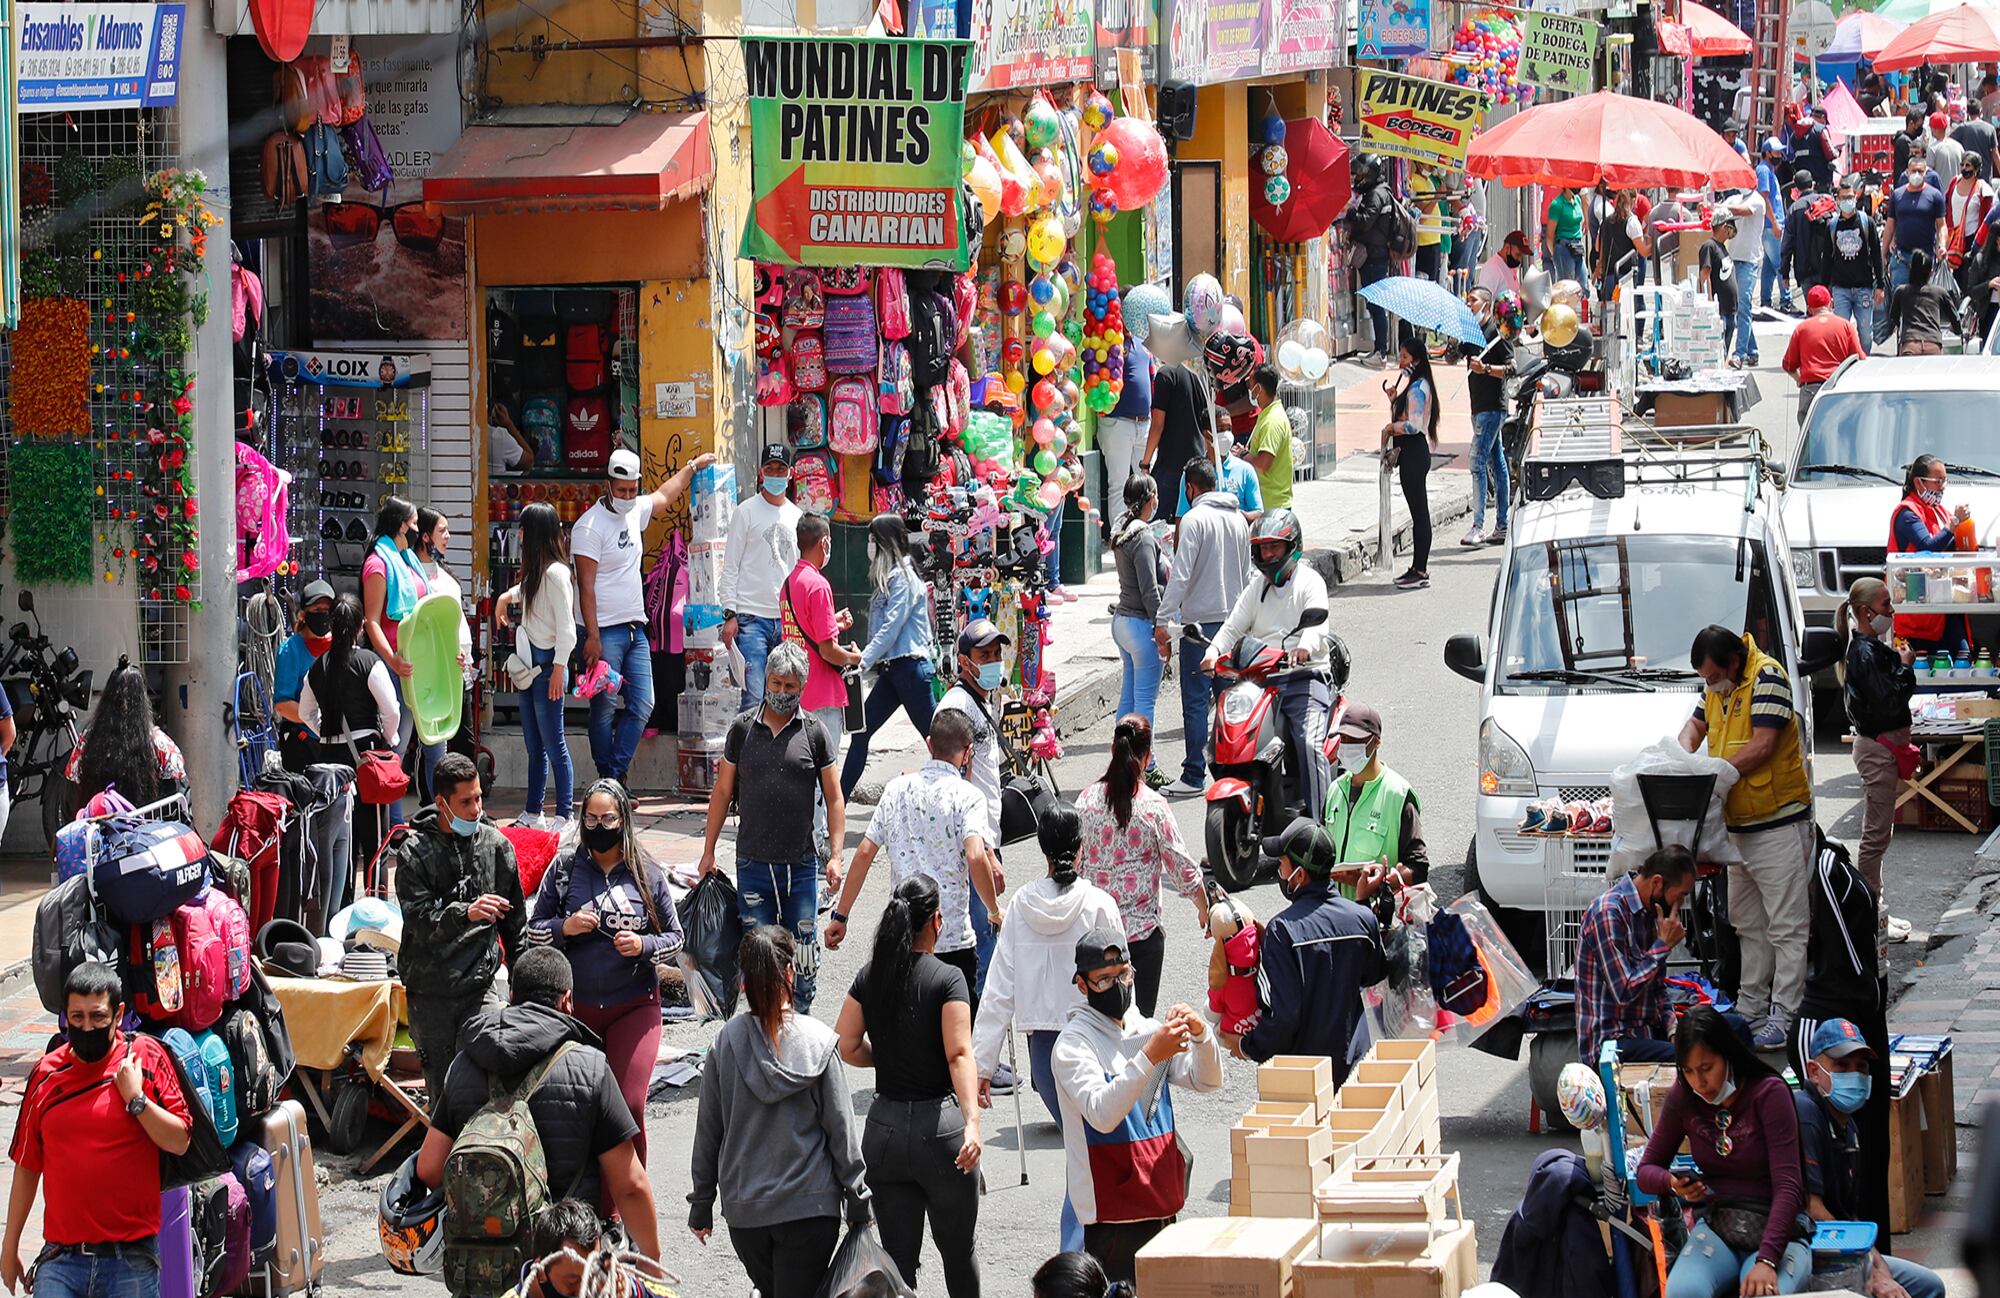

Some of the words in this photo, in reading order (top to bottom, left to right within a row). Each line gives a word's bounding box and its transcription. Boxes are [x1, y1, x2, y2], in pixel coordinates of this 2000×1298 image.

[21, 14, 84, 51] Ensambles
[87, 15, 96, 50] Y
[96, 14, 143, 50] Adornos
[1002, 25, 1050, 54] Distribuidores
[1051, 17, 1087, 52] Mayoristas
[1382, 29, 1412, 42] BODEGA
[1541, 16, 1584, 36] OFERTA
[1533, 31, 1540, 44] Y
[1542, 33, 1588, 53] BODEGA
[370, 61, 380, 72] es
[383, 57, 433, 73] fascinante,
[1525, 46, 1541, 60] DE
[1543, 50, 1591, 70] PATINES
[746, 40, 913, 101] MUNDIAL
[923, 43, 967, 102] DE
[376, 82, 392, 94] que
[395, 78, 428, 93] mirarla
[1364, 75, 1476, 121] PATINES
[375, 100, 386, 114] de
[389, 99, 402, 114] las
[404, 99, 429, 116] gafas
[780, 102, 931, 165] PATINES
[1386, 117, 1454, 142] BODEGA
[387, 151, 432, 166] ADLER
[809, 189, 946, 213] DISTRIBUIDORES
[810, 214, 945, 245] CANARIAN
[327, 360, 369, 376] LOIX
[569, 449, 599, 459] adidas
[176, 862, 202, 886] HILFIGER
